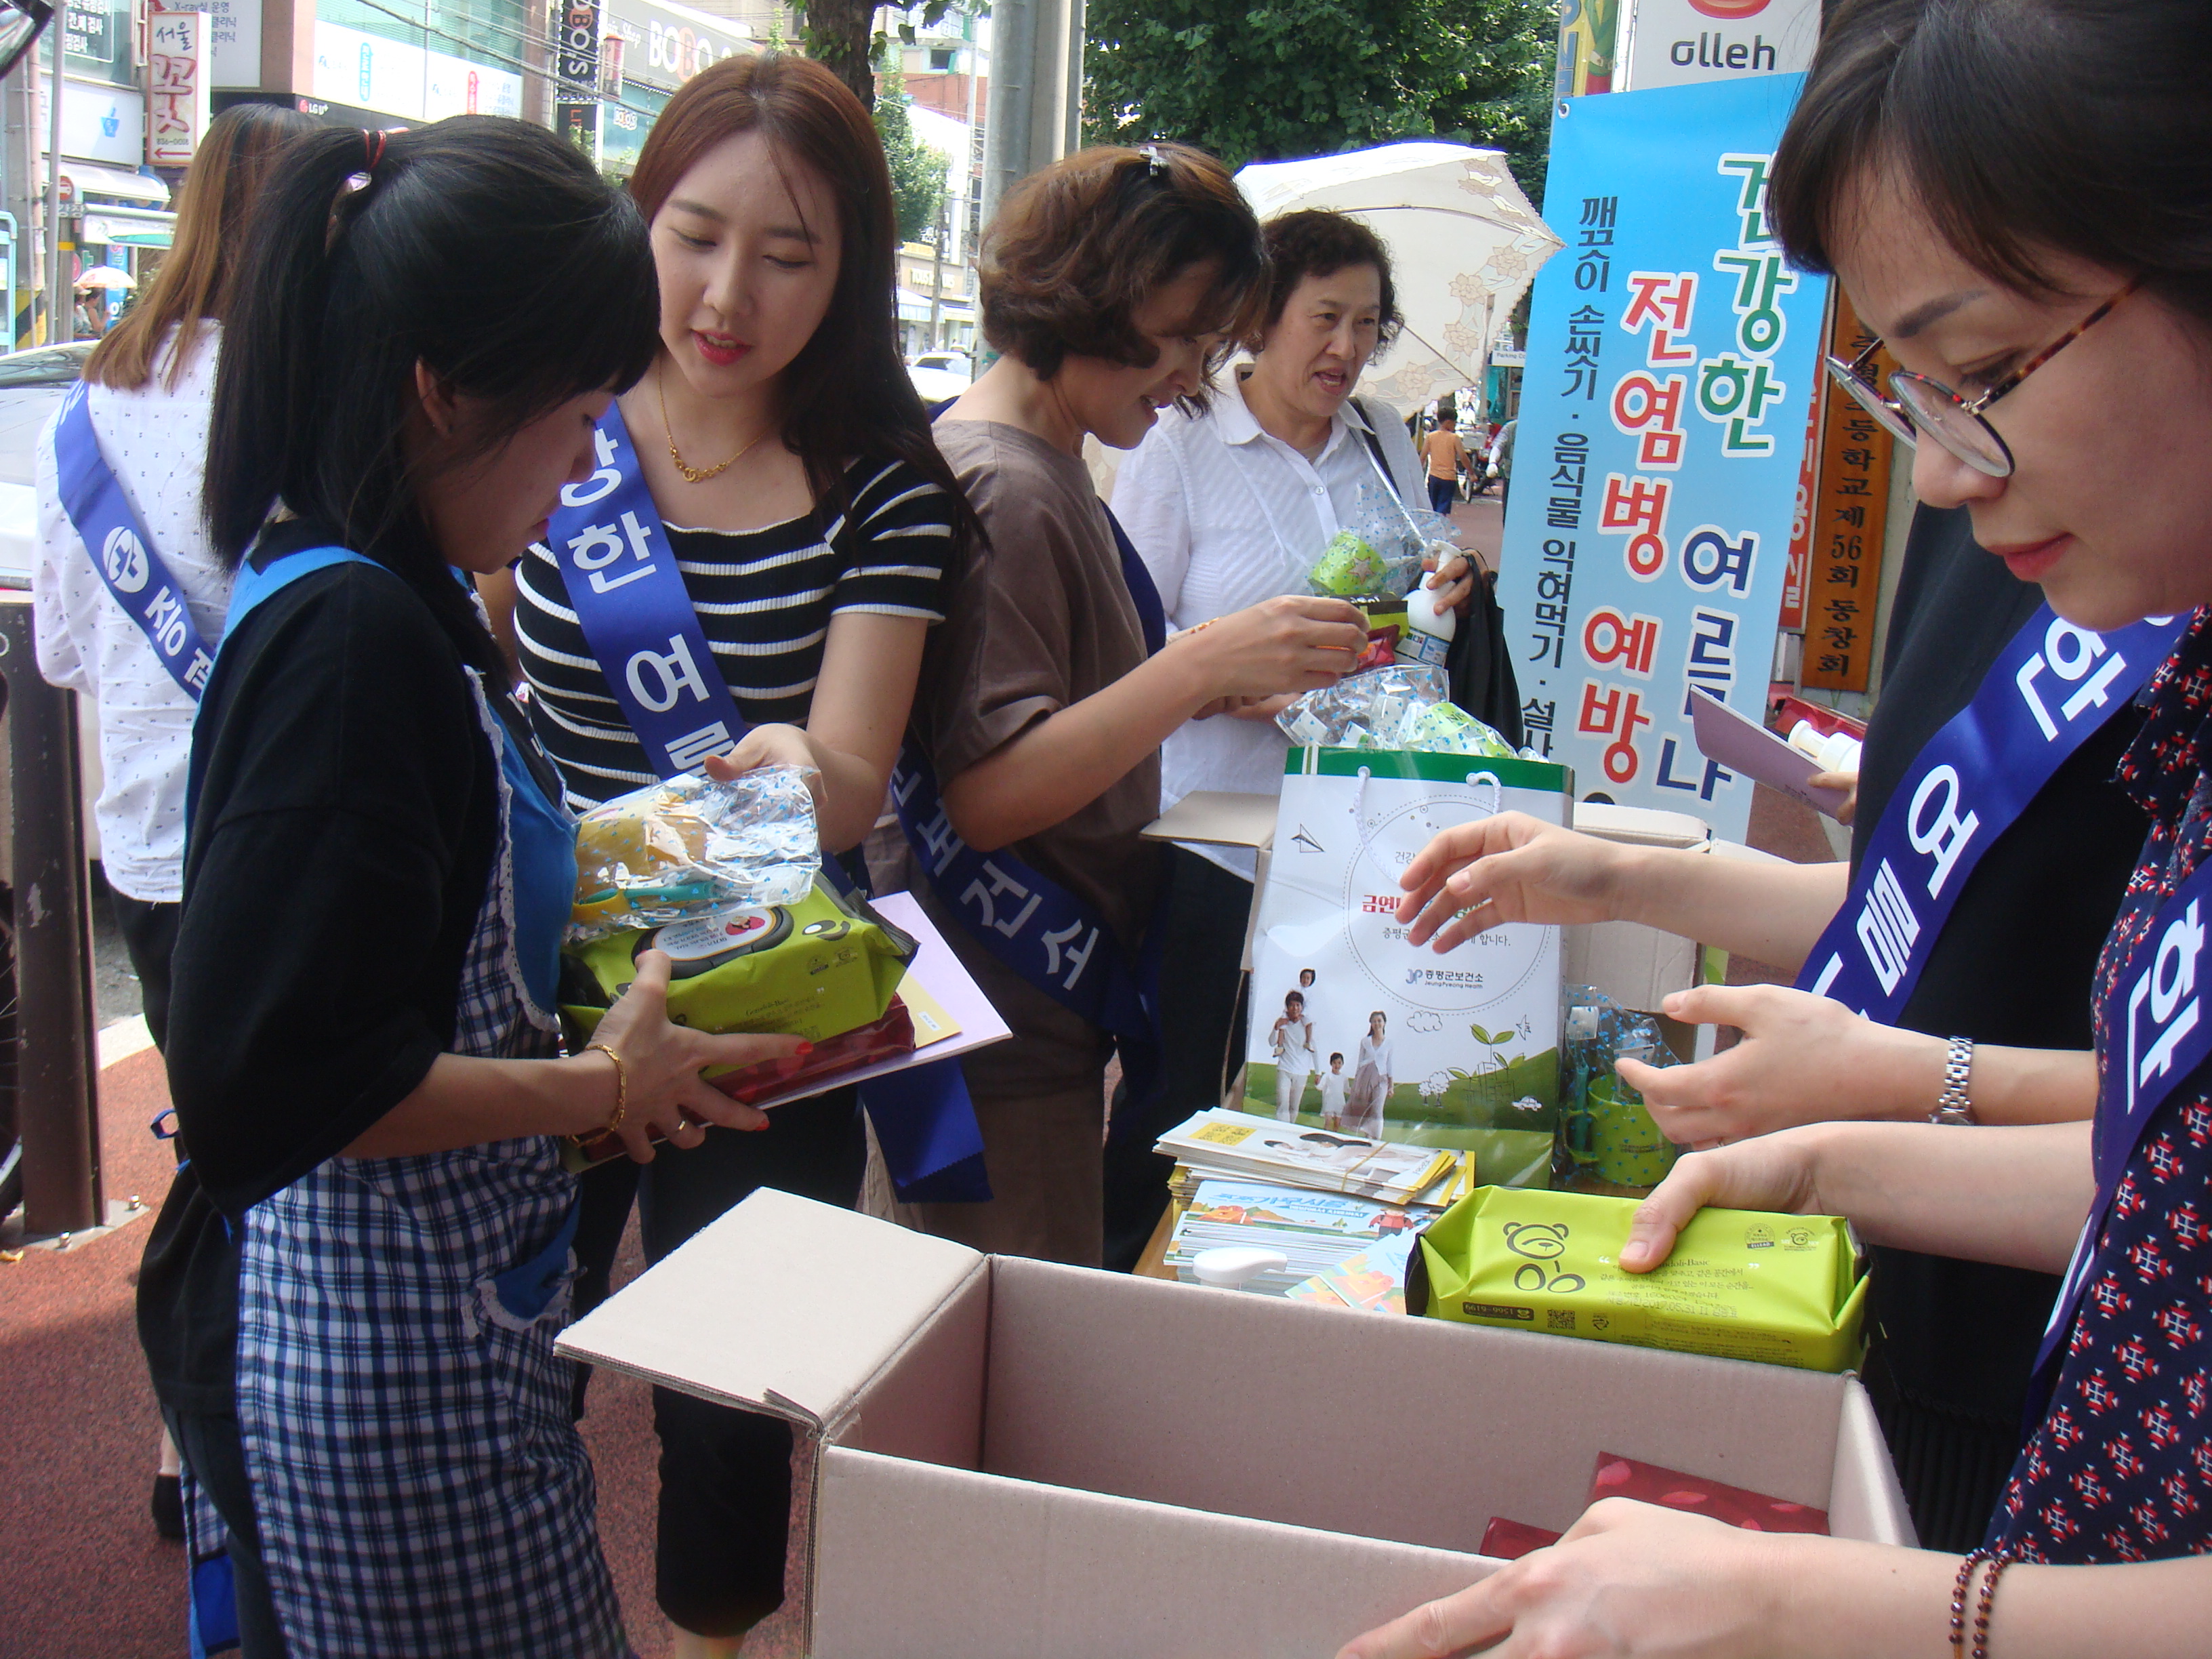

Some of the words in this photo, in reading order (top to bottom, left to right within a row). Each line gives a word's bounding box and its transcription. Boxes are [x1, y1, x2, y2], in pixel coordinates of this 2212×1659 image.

[156, 22, 192, 51] 서울
[1670, 32, 1776, 71] olleh
[150, 54, 197, 134] 꽃
[1573, 196, 1618, 293] 깨끗이
[1560, 304, 1605, 401] 손씻기
[1599, 274, 1696, 577] 전염병
[1546, 432, 1590, 529] 음식물
[1826, 506, 1866, 589] 제56회
[1529, 539, 1576, 669] 익혀먹기
[1817, 599, 1860, 678] 동창회
[1578, 611, 1658, 785] 예방
[1856, 764, 1980, 998] 여름
[1425, 969, 1484, 983] 증평군보건소
[1479, 934, 1511, 947] 합니다.
